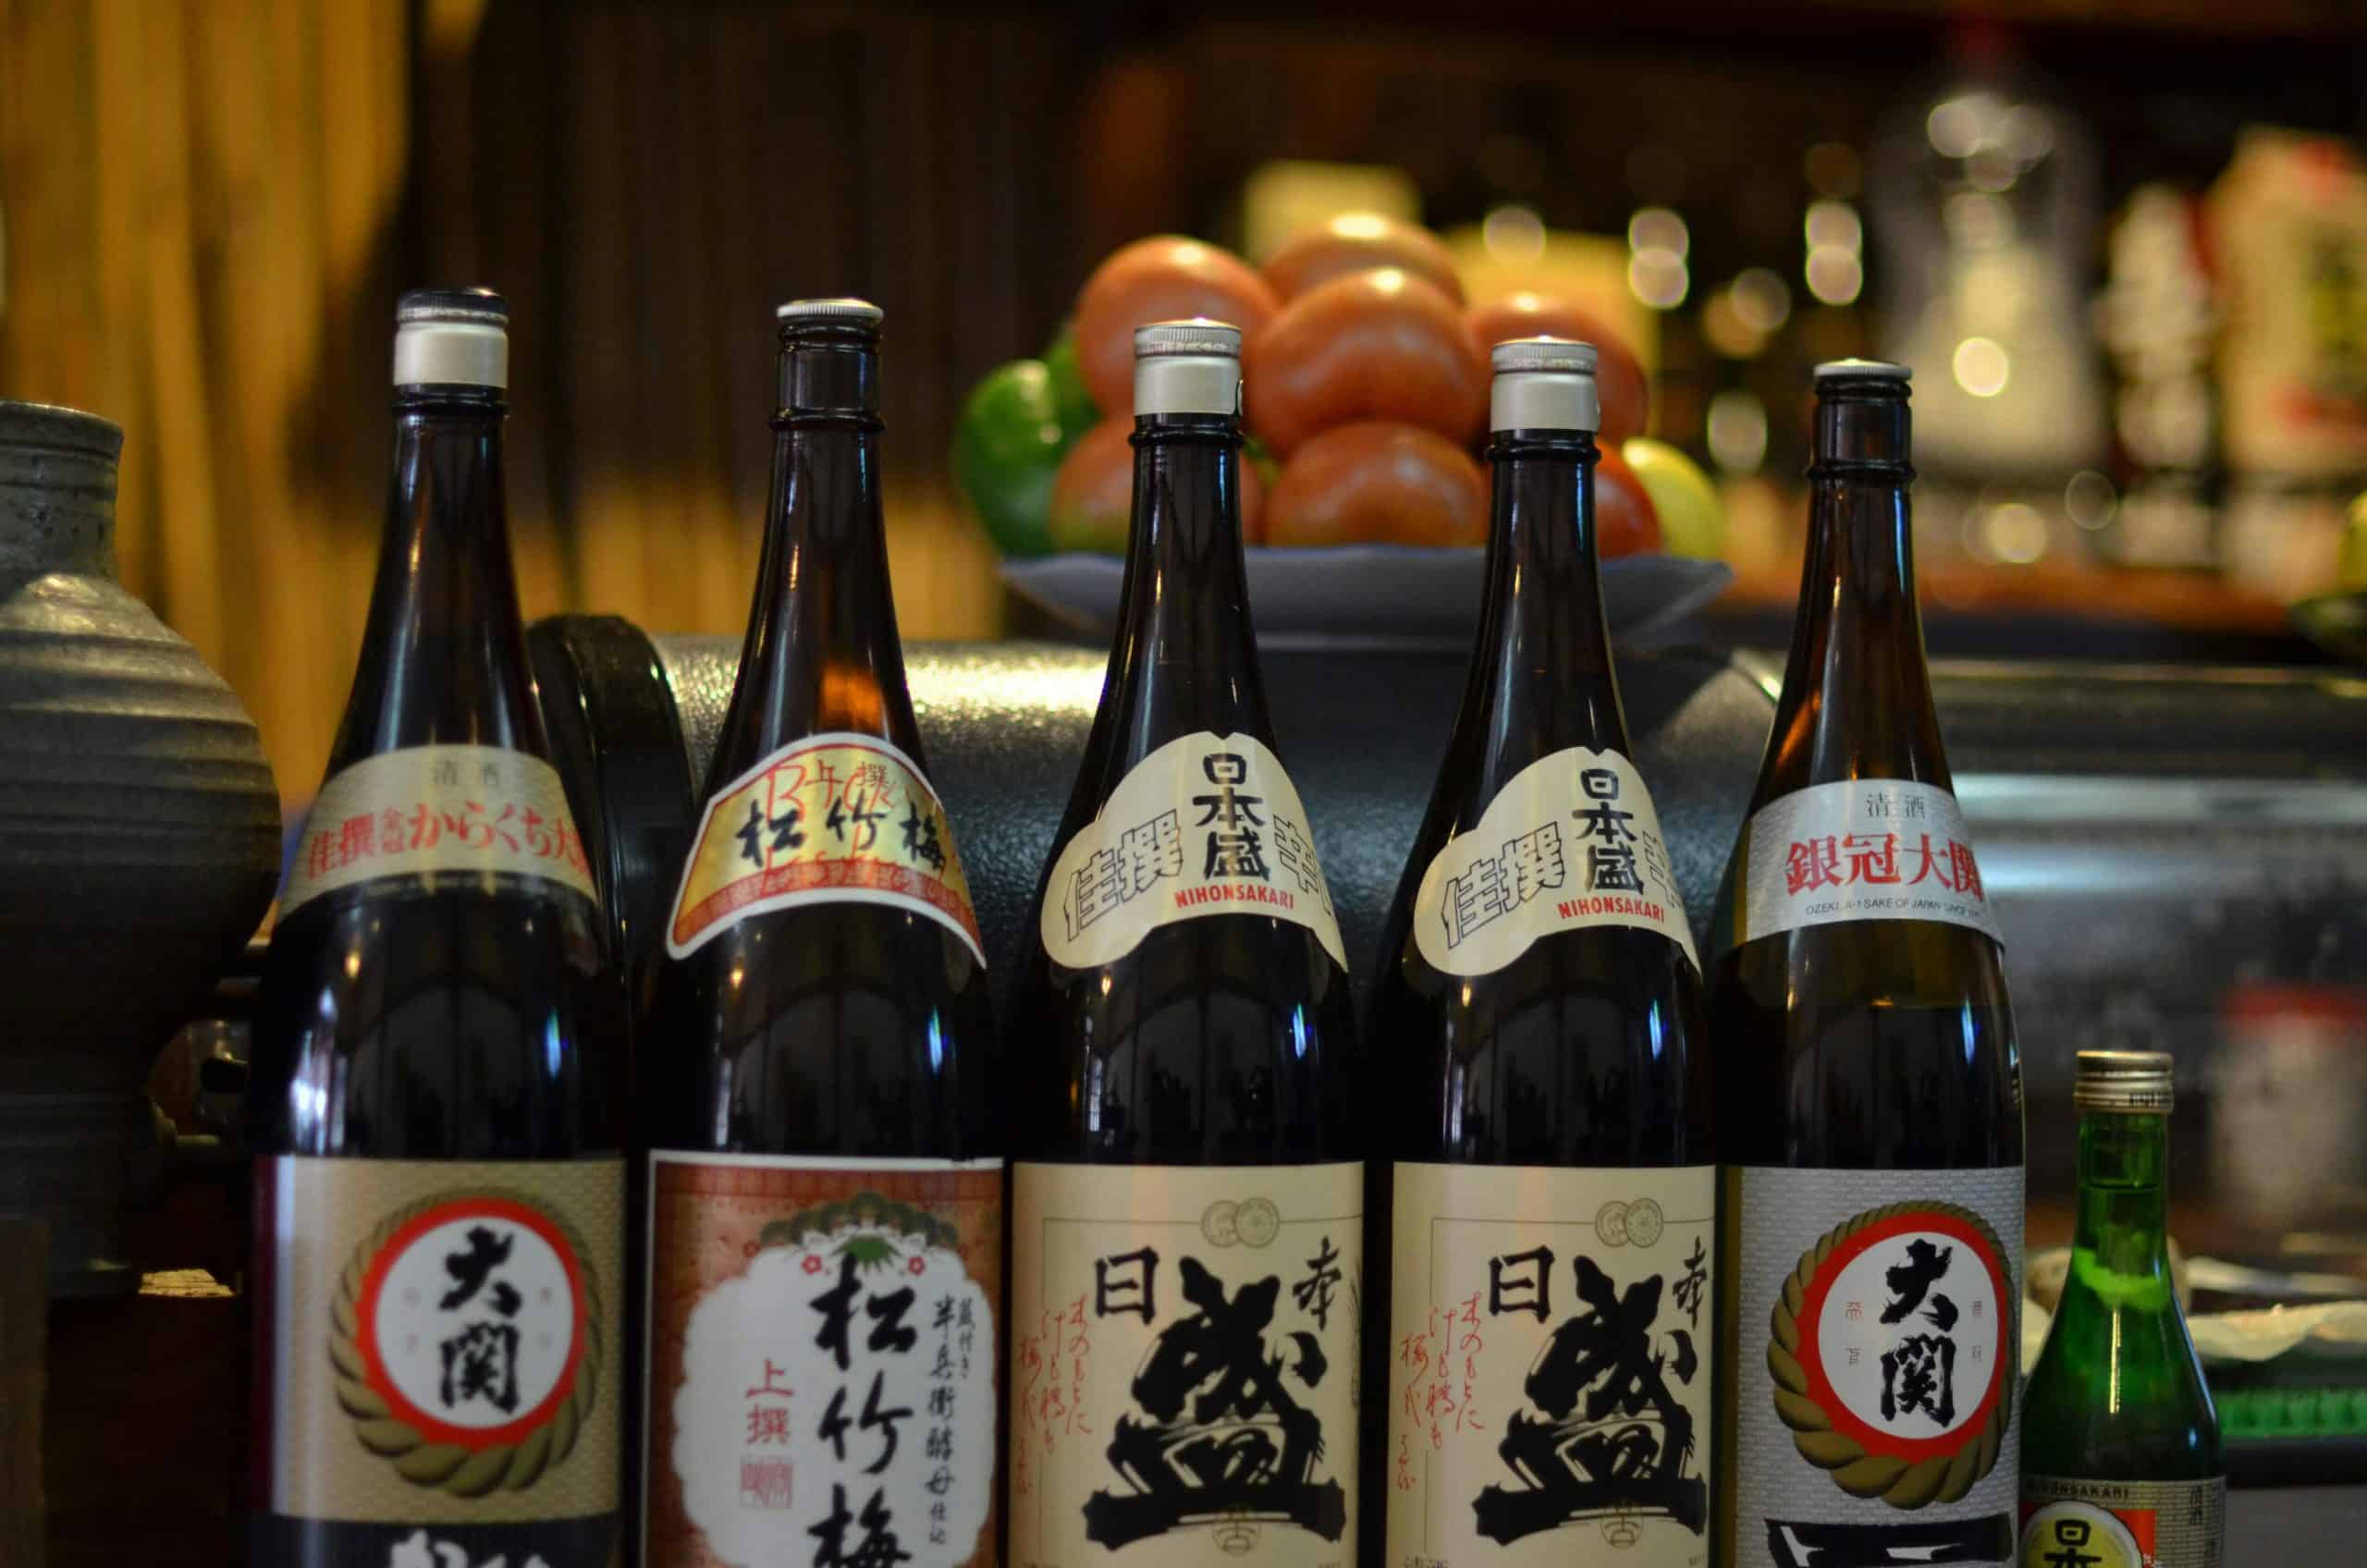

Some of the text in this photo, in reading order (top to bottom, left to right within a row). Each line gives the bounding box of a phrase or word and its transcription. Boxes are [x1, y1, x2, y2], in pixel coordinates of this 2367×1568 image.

[736, 789, 947, 867] 松竹梅
[1193, 753, 1267, 881] 日本盛
[1572, 768, 1645, 894] 日本盛
[1867, 791, 1925, 819] 清酒
[1174, 882, 1294, 911] NIHONSAKARI
[1557, 896, 1665, 925] NIHONSAKARI
[1863, 896, 1895, 910] SAKE
[745, 1358, 795, 1444] 上撰
